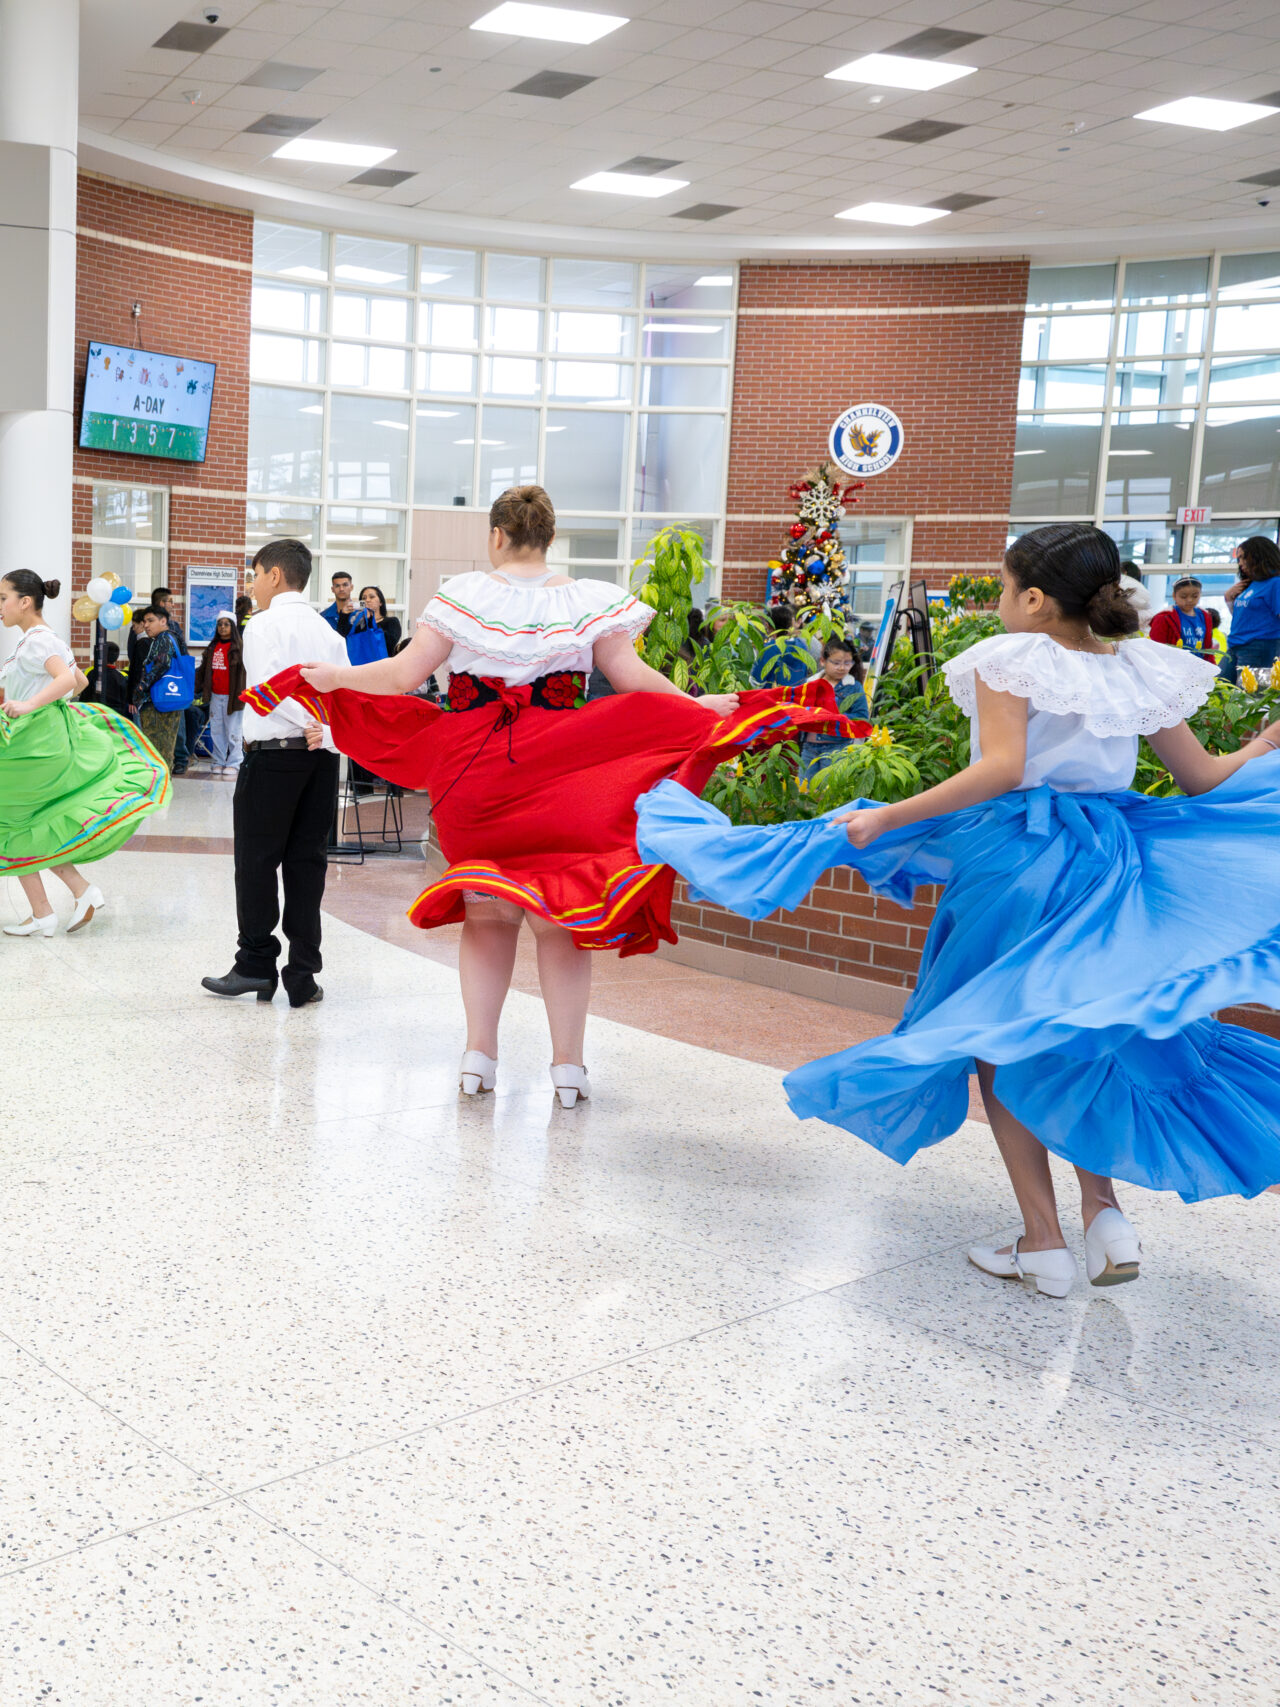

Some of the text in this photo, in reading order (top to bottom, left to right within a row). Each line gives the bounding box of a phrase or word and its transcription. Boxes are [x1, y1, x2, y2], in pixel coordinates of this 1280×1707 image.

[133, 394, 165, 415] A-DAY
[839, 407, 897, 429] CHANNELVIEW
[111, 419, 176, 449] 1 3 5 7
[861, 453, 895, 473] SCHOOL
[1183, 508, 1207, 523] EXIT
